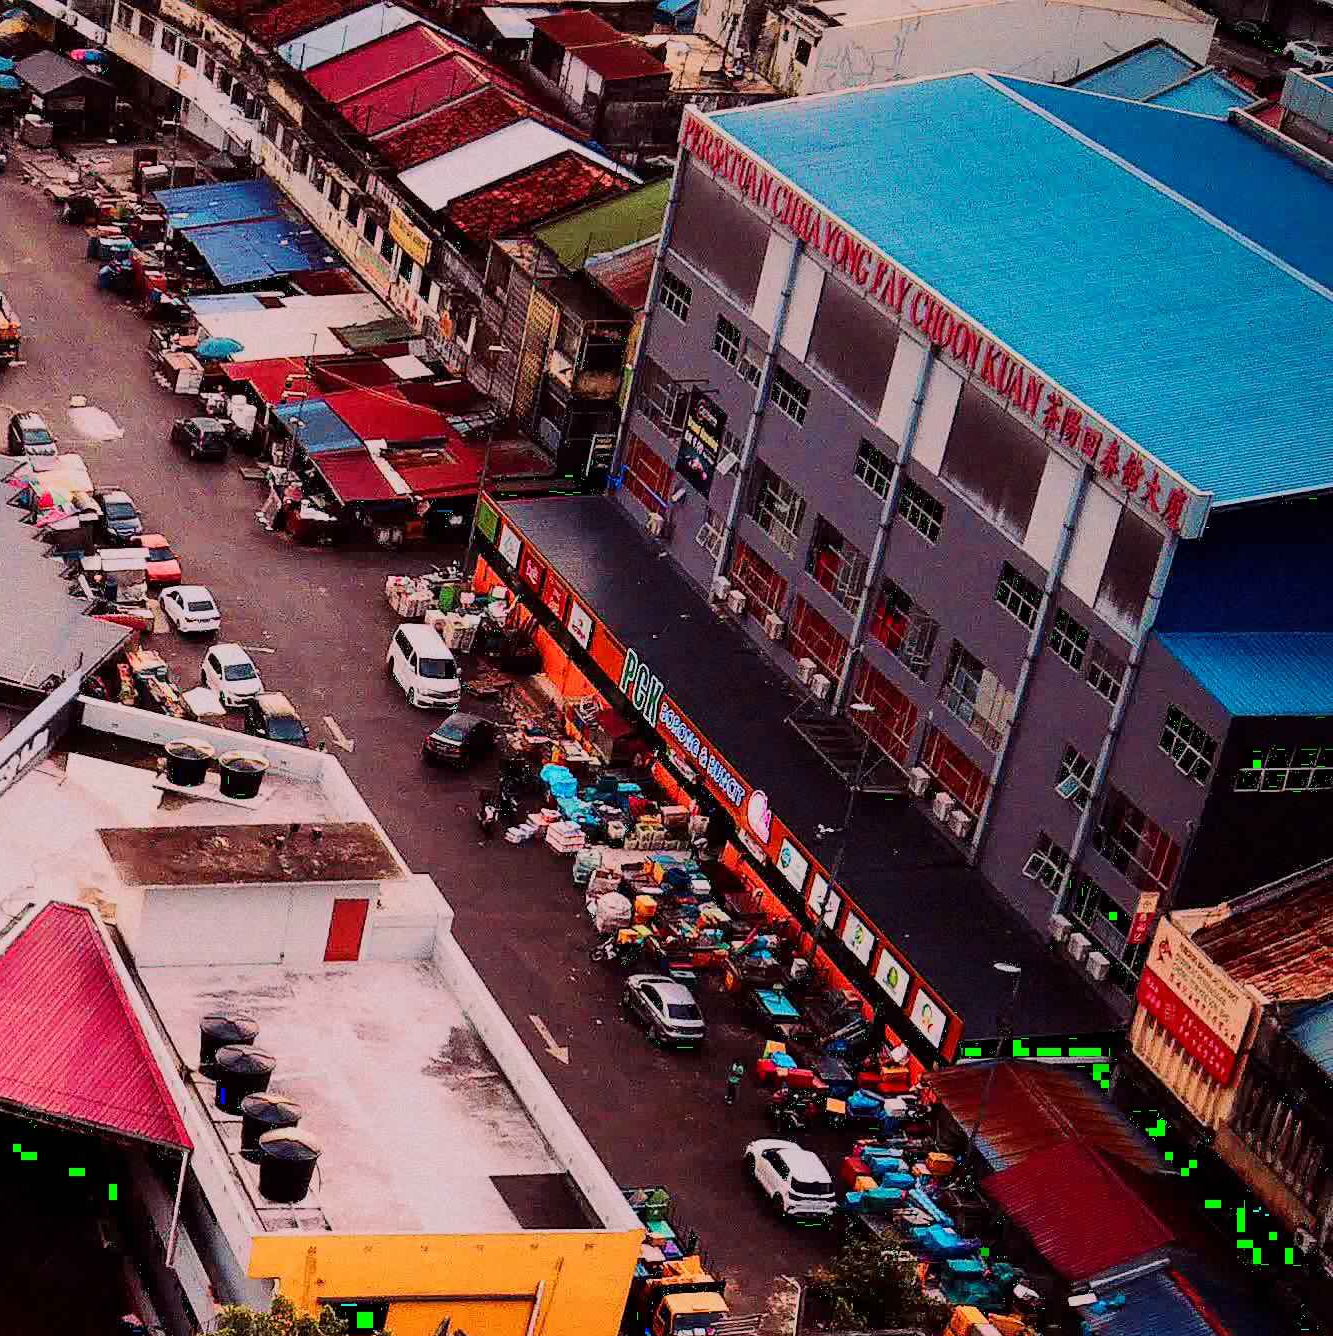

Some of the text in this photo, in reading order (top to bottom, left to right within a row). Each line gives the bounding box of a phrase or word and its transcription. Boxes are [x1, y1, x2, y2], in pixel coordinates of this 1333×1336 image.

[681, 116, 773, 207] PERSATUAN
[821, 219, 872, 285] YONG
[870, 262, 912, 315] FAY
[910, 291, 983, 369] CHOON
[982, 345, 1044, 418] KUAN
